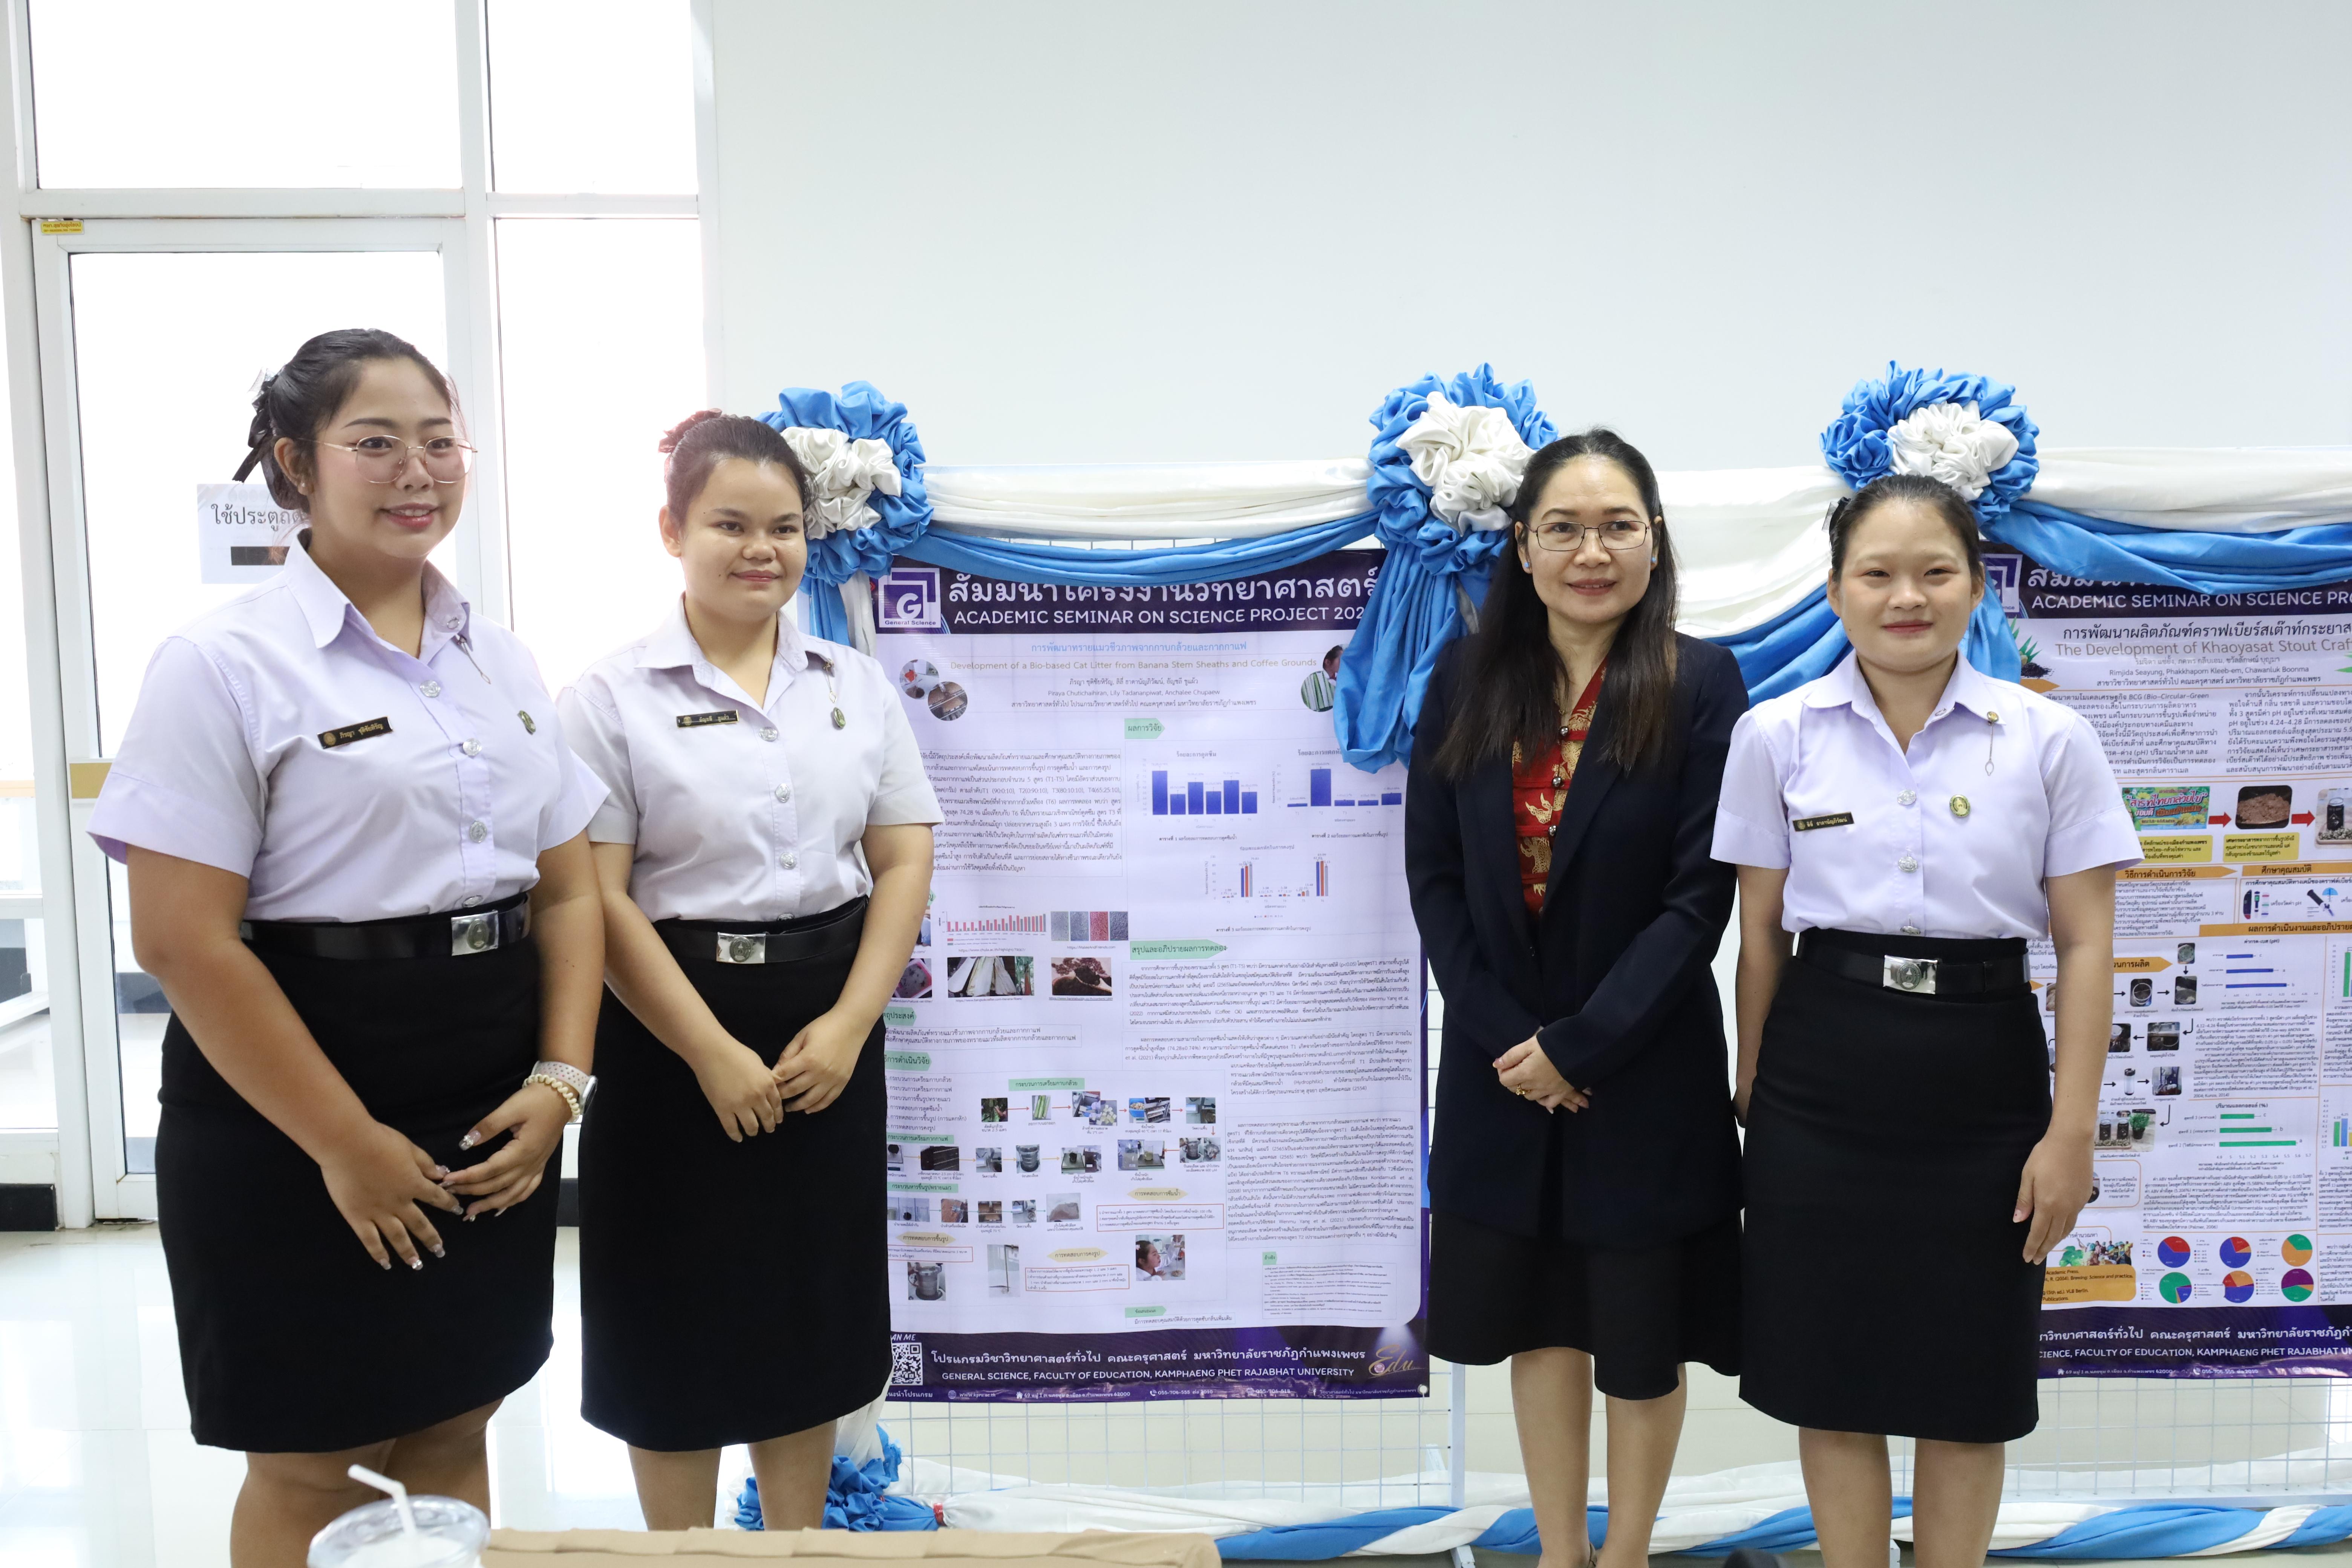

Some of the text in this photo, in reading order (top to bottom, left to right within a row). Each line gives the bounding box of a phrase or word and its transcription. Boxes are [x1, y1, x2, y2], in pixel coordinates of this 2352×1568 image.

[2032, 596, 2126, 609] ACADEMIC
[2132, 593, 2210, 607] SEMINAR
[2216, 594, 2241, 606] ON
[2246, 592, 2322, 606] SCIENCE
[954, 606, 1364, 624] ACADEMIC SEMINAR ON SCIENCE PROJECT 202
[2055, 644, 2081, 656] The
[2086, 642, 2179, 657] Development
[2184, 642, 2197, 654] of
[2202, 641, 2274, 655] Khaoyasat
[2279, 640, 2317, 652] Stout
[951, 661, 1008, 671] Development
[1251, 659, 1279, 667] Coffee
[1281, 658, 1317, 666] Grounds
[1128, 723, 1162, 732] ผลการวิจัย
[2125, 868, 2196, 879] วิธีการดำเนินการวิจัย
[2261, 864, 2312, 875] ศึกษาคุณสมบัติ
[2150, 1327, 2231, 1343] คณะครุศาสตร์
[931, 1348, 1366, 1365] โปรแกรมวิชาวิทยาศาสตร์ทั่วไป คณะครุศาสตร์ มหาวิทยาลัยราชภัฏกำแพงเพชร
[2135, 1349, 2195, 1358] EDUCATION,
[988, 1372, 1031, 1381] SCIENCE,
[1093, 1370, 1152, 1379] EDUCATION,
[1155, 1369, 1215, 1377] KAMPHAENG
[1245, 1368, 1295, 1376] RAJABHAT
[1297, 1368, 1354, 1376] UNIVERSITY
